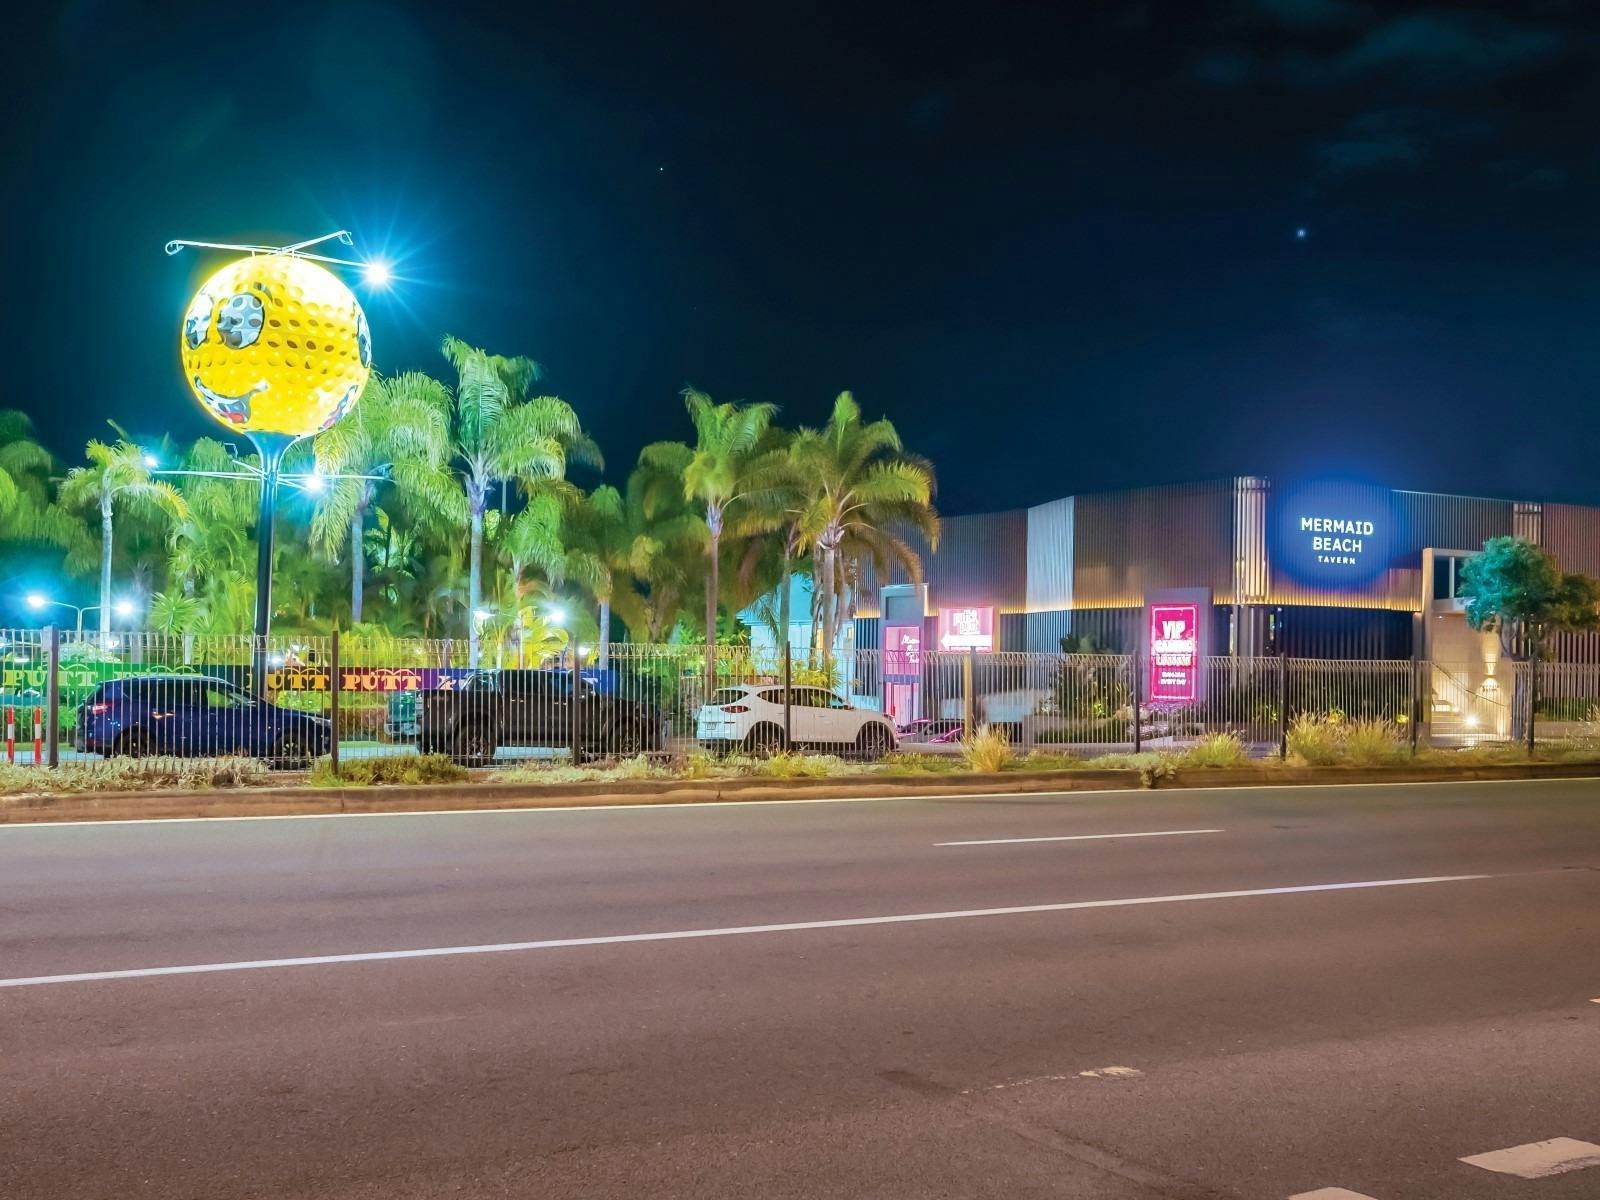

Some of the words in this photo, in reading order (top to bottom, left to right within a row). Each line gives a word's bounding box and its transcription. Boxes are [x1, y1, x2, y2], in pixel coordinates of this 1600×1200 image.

[1301, 517, 1374, 536] MERMAID
[1312, 536, 1362, 553] BEACH
[1318, 555, 1356, 565] TAVERN
[1162, 620, 1186, 640] VIP
[342, 674, 422, 690] PUTT
